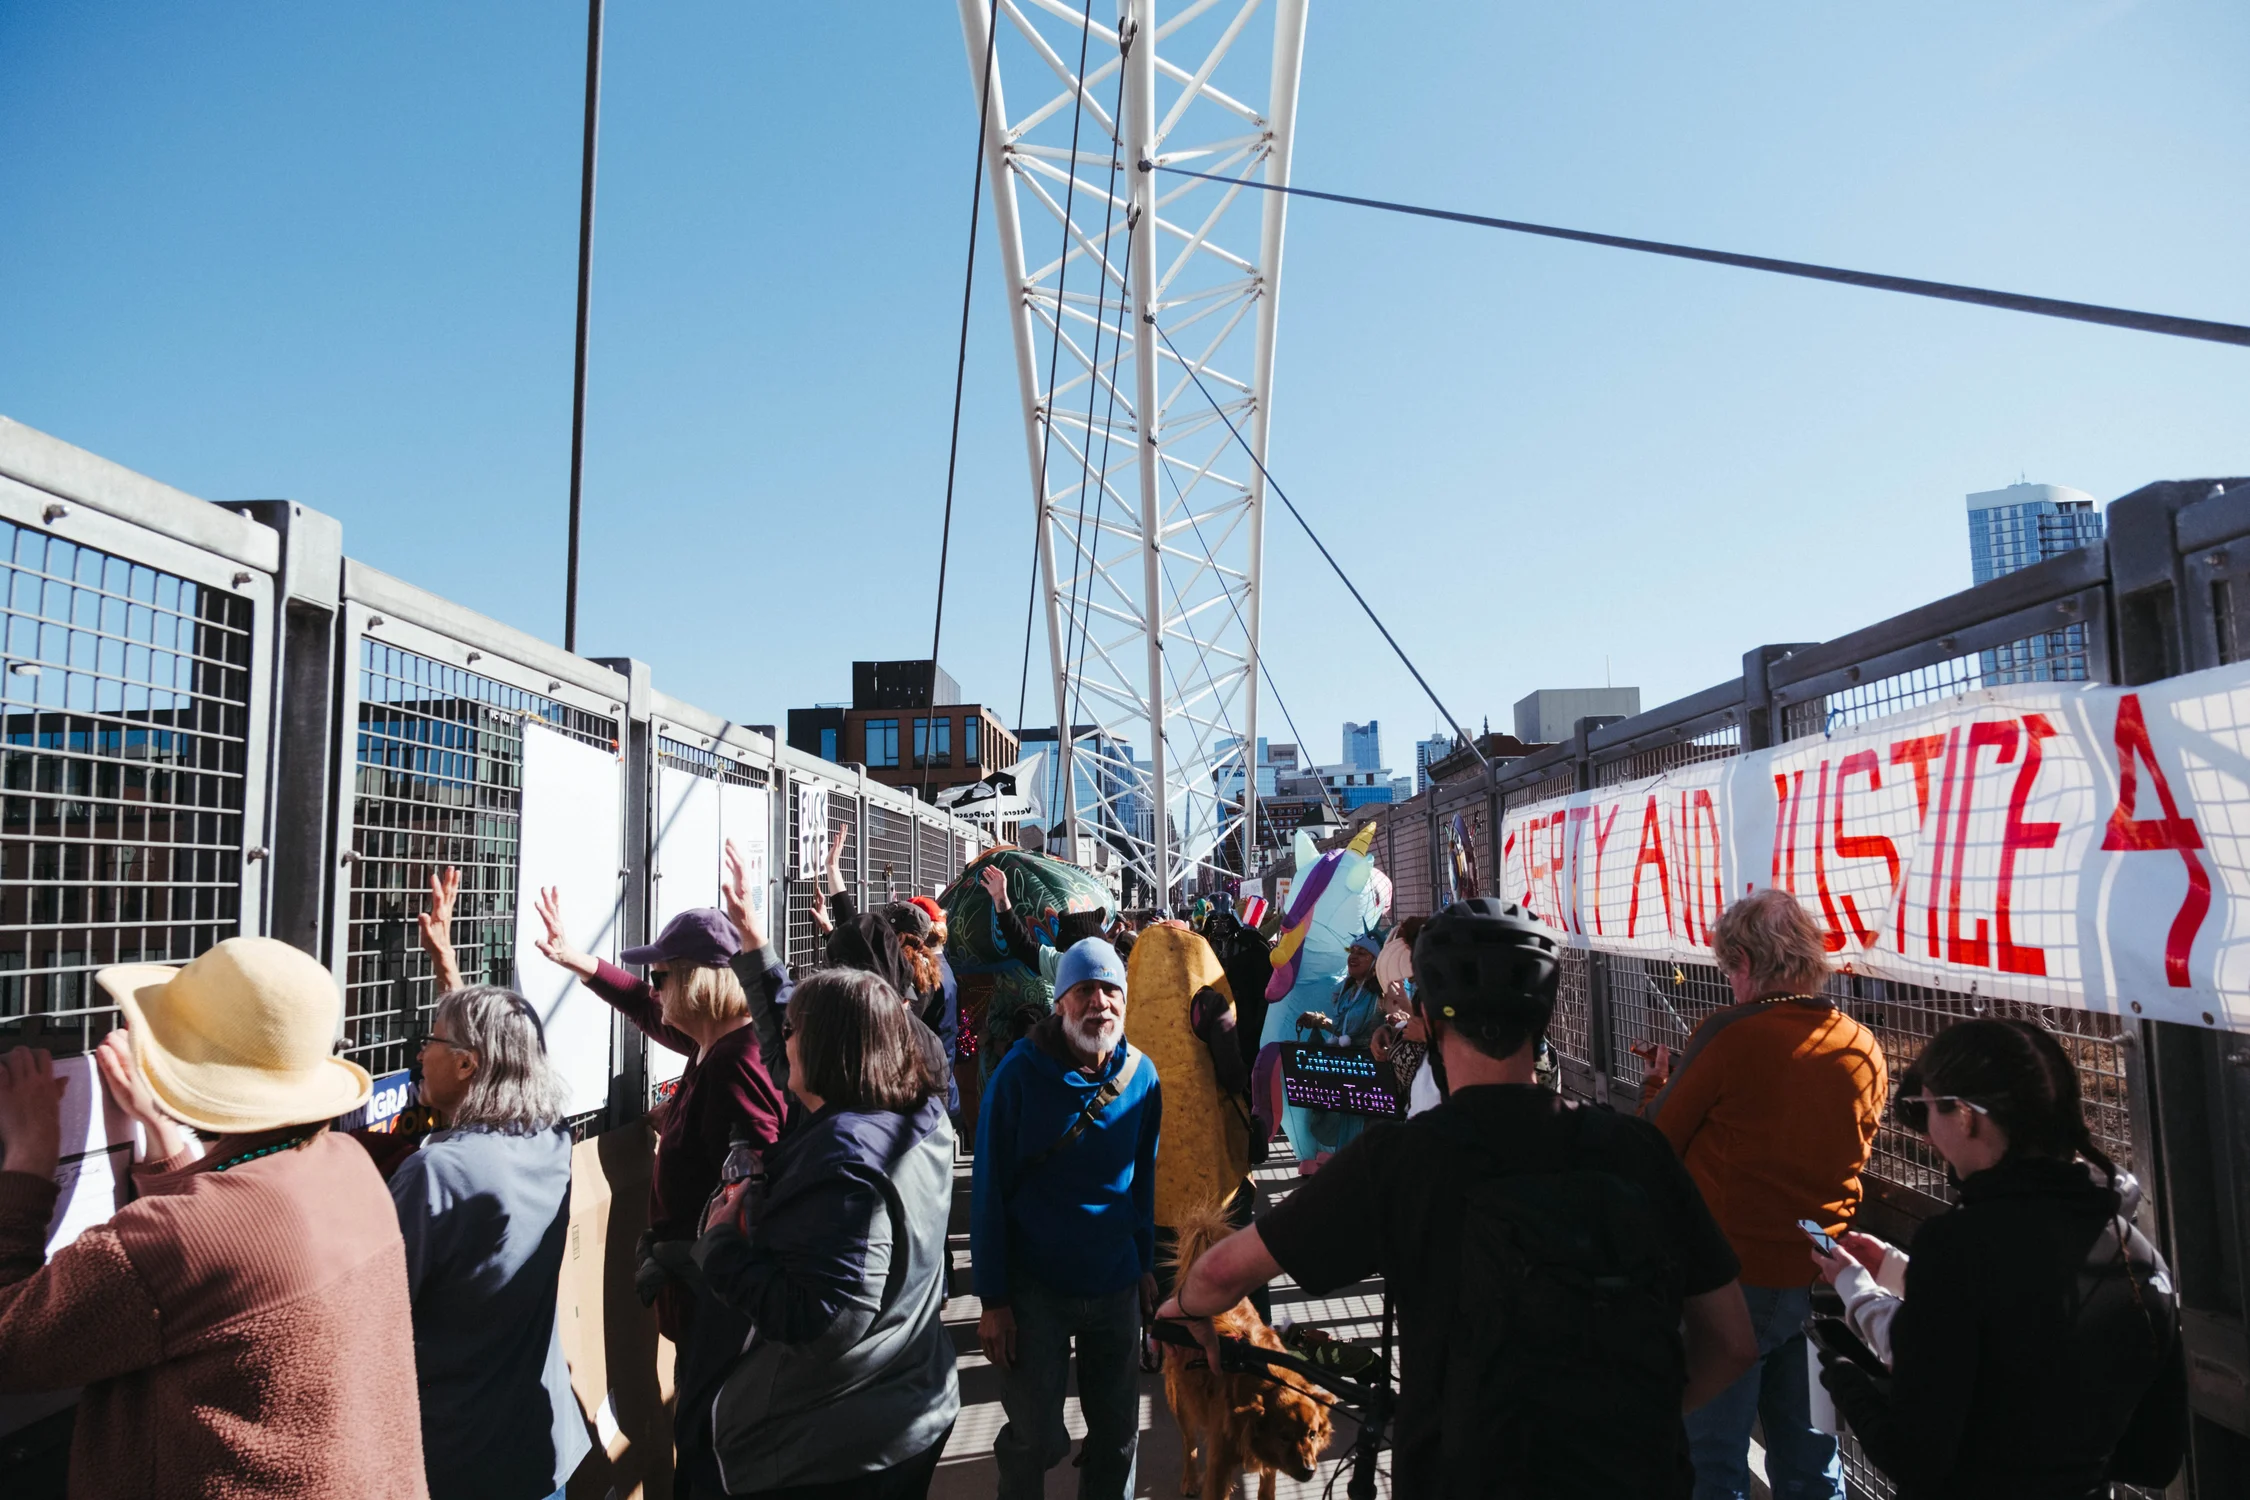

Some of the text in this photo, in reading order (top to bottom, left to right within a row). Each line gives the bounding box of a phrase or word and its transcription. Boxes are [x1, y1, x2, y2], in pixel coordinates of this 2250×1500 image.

[802, 791, 826, 831] FUCK
[803, 834, 825, 874] ICE
[1628, 789, 1724, 947] AND
[1747, 713, 2061, 977] JUSTICE
[1286, 1077, 1395, 1113] Bridge Trolls
